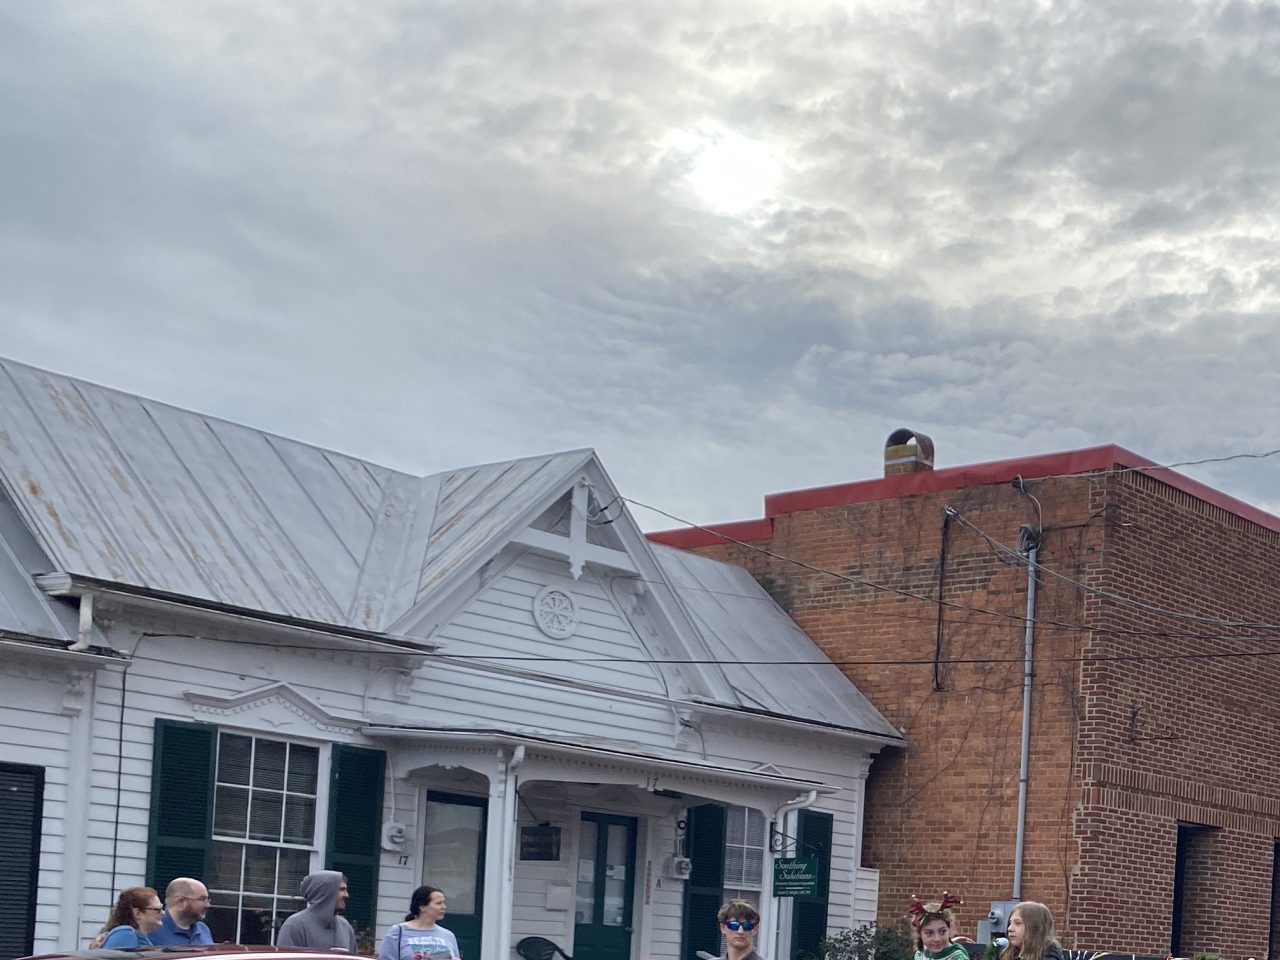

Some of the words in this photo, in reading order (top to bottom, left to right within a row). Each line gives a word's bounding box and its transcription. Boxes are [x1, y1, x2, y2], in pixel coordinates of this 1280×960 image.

[398, 855, 409, 866] 17
[774, 859, 807, 873] Soothing
[779, 869, 815, 880] Solutions
